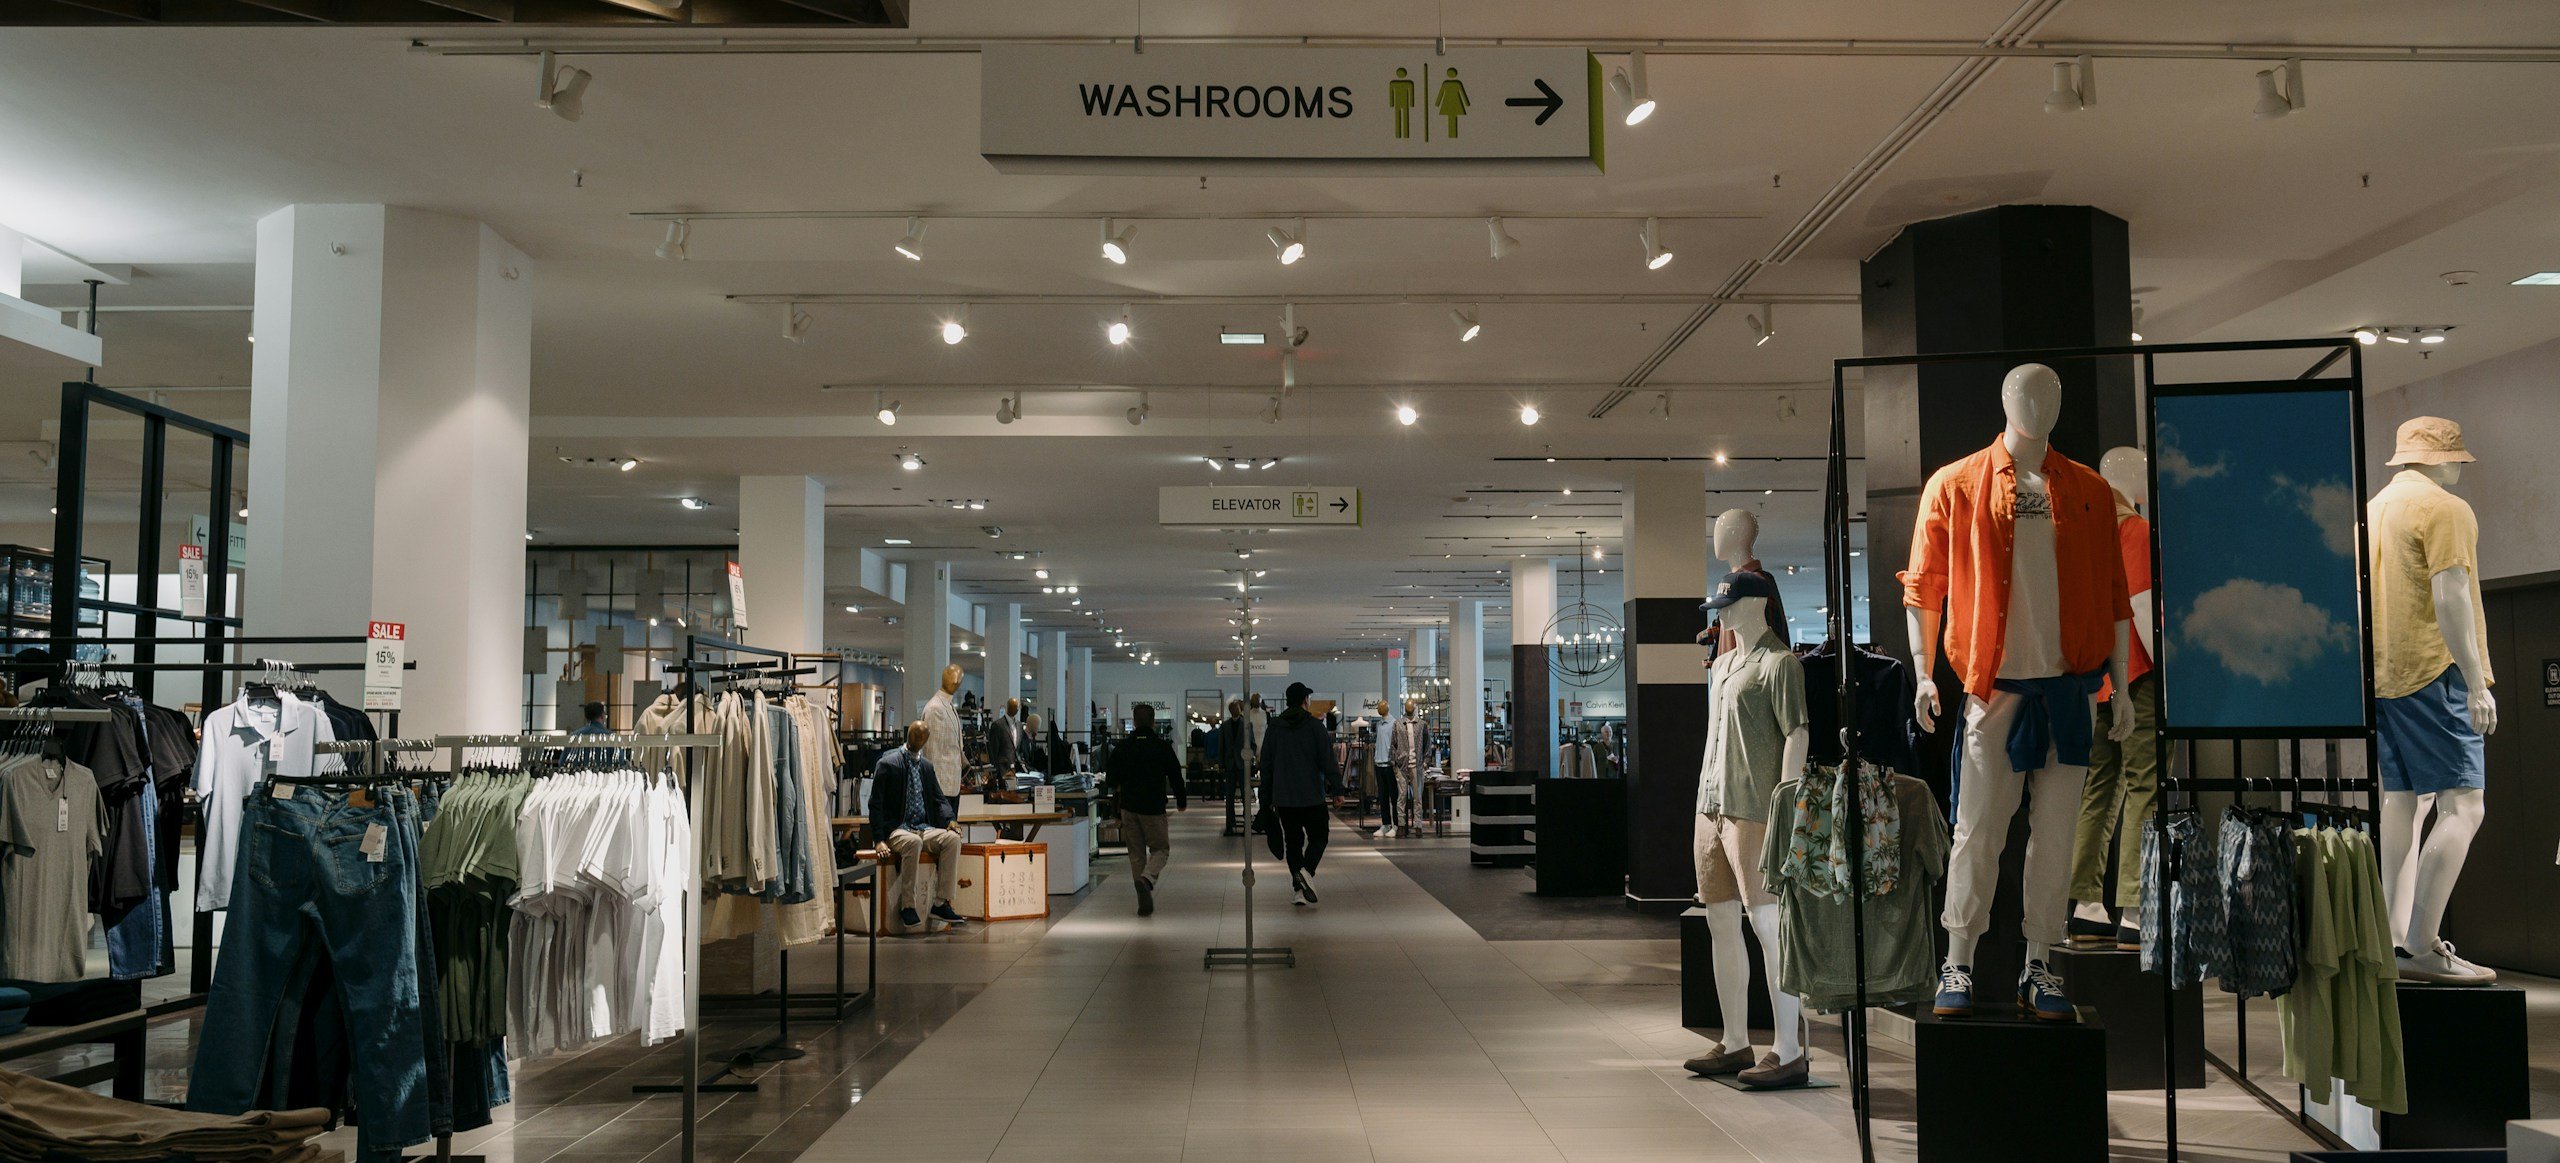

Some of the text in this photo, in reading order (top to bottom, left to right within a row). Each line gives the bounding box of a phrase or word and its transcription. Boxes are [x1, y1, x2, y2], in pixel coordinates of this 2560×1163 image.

[1078, 82, 1354, 119] WASHROOMS
[1212, 498, 1281, 511] ELEVATOR
[2016, 498, 2046, 511] Ralph
[229, 535, 246, 550] FITTI
[182, 546, 200, 559] SALE
[185, 568, 199, 580] 15%
[372, 622, 400, 640] SALE
[376, 651, 396, 664] 15%
[1585, 700, 1625, 709] Calvin Klein
